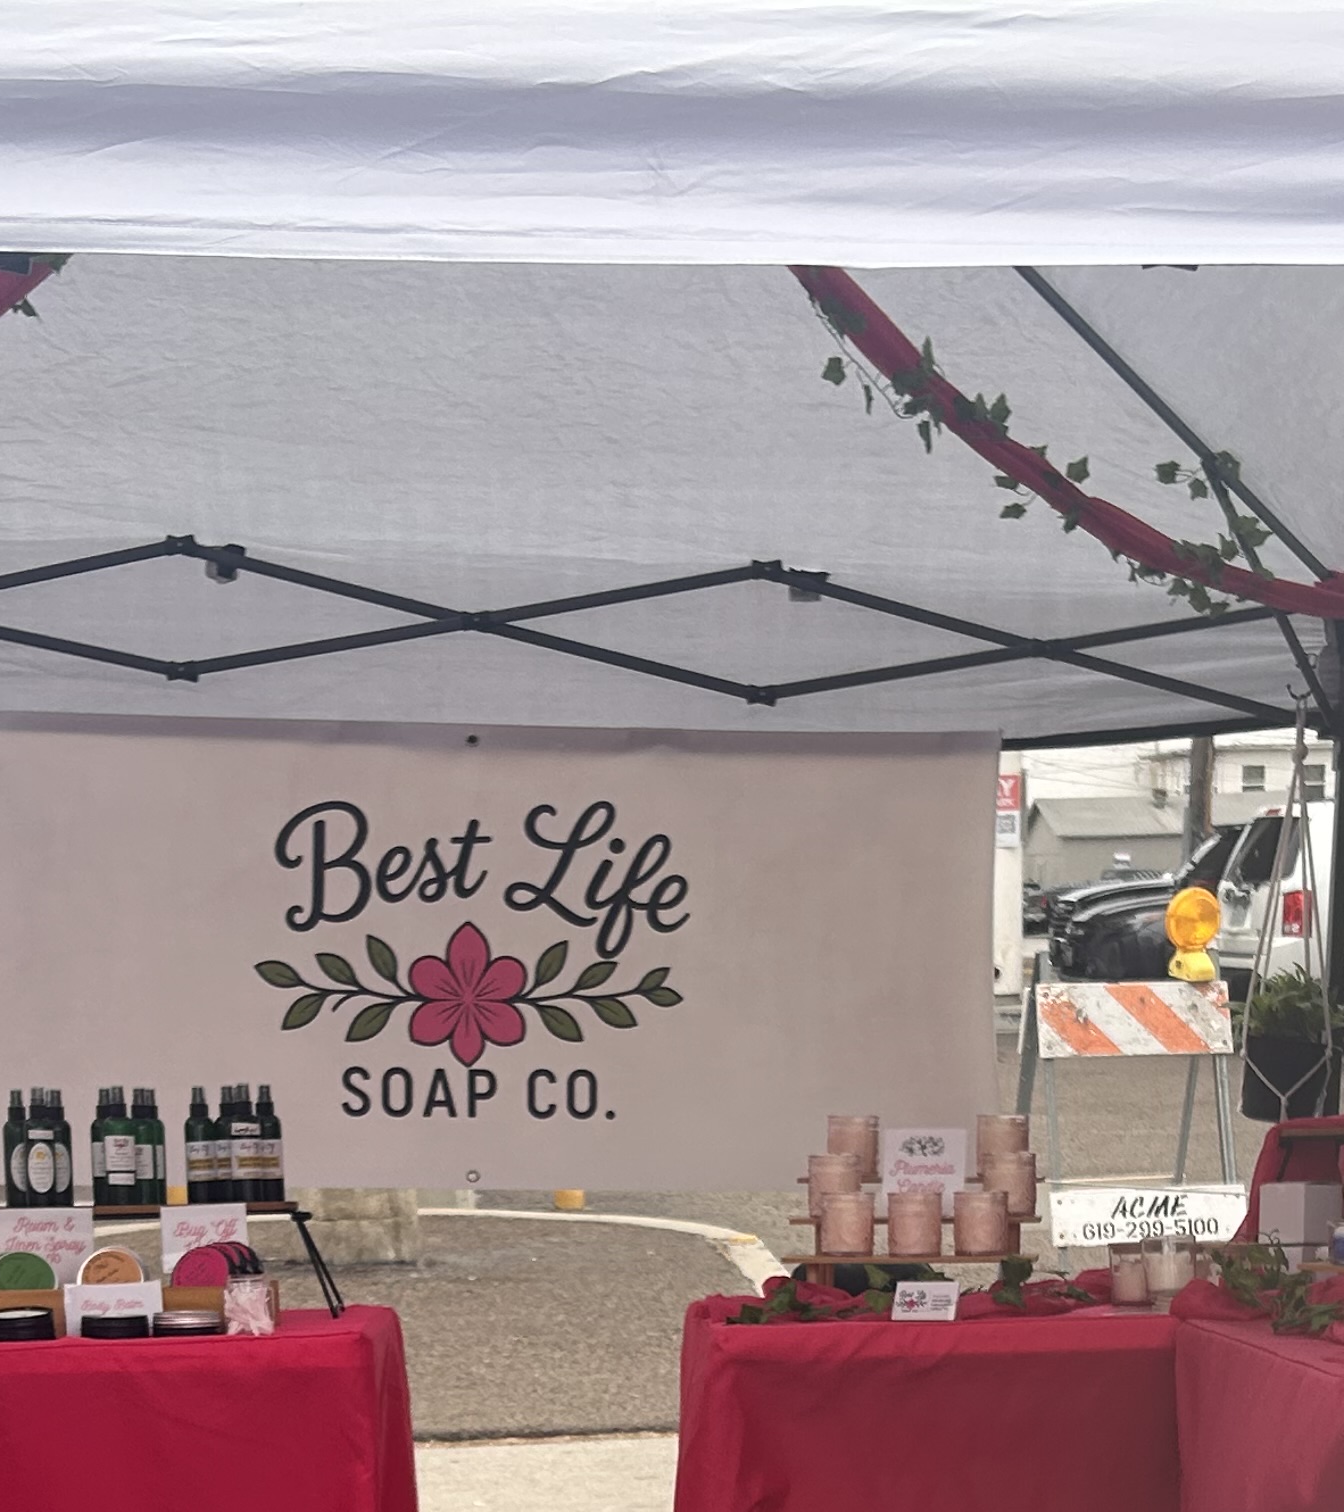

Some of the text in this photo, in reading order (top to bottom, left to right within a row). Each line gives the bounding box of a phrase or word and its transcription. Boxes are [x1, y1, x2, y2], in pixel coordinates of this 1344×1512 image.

[274, 801, 691, 960] Best Life
[340, 1066, 617, 1120] SOAP CO.
[888, 1159, 955, 1177] Plumeria
[1110, 1194, 1189, 1220] ACME
[13, 1215, 76, 1234] Room &
[1082, 1218, 1219, 1241] 619-299-5100
[44, 1235, 88, 1256] Spray
[80, 1300, 112, 1315] Body
